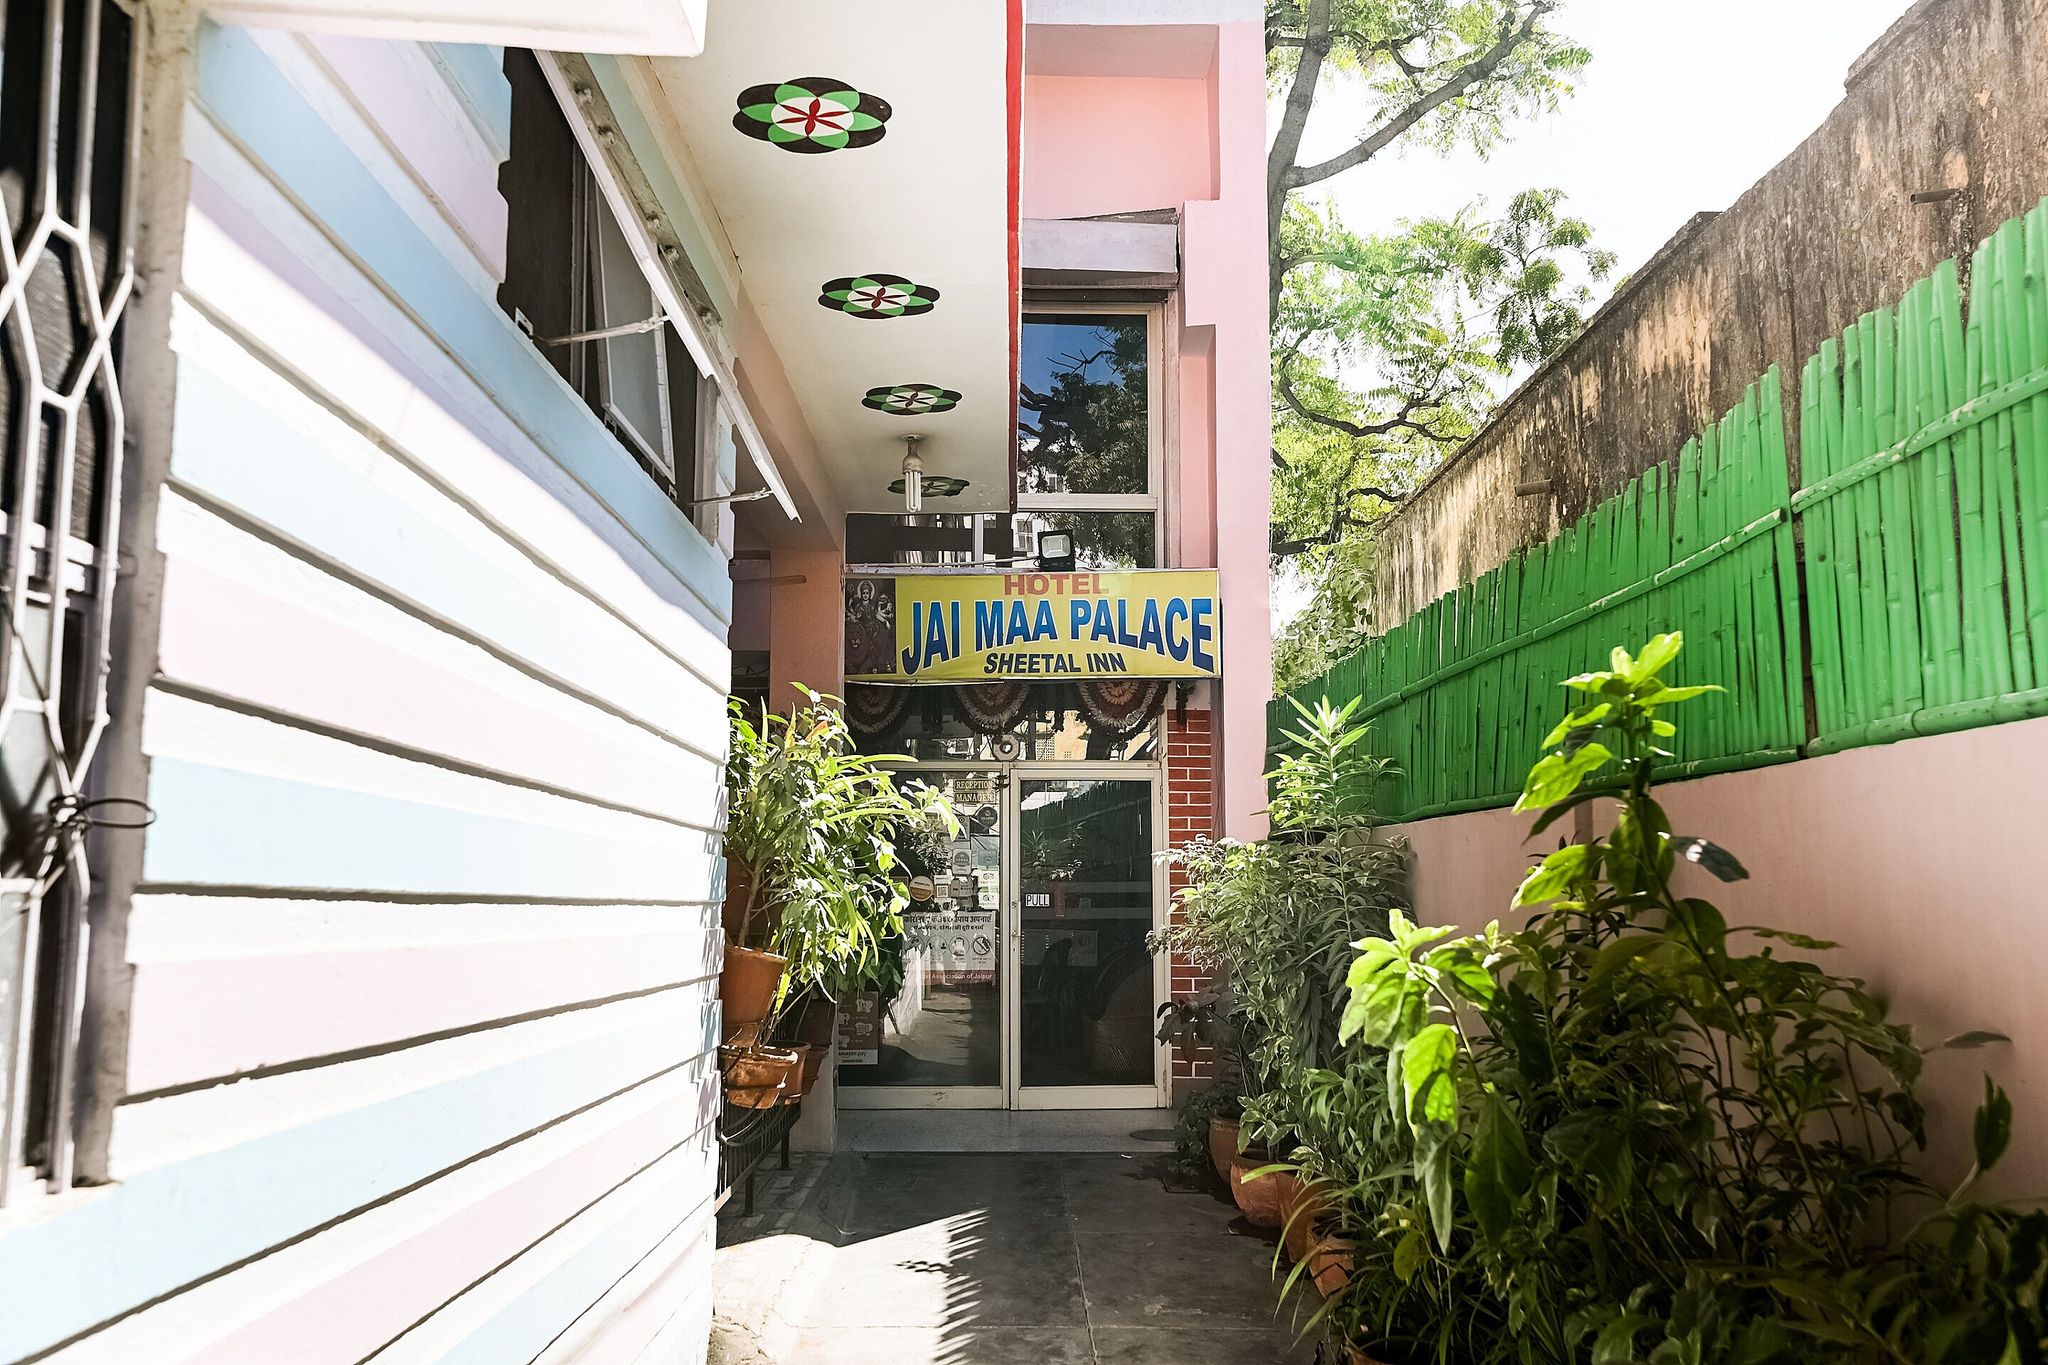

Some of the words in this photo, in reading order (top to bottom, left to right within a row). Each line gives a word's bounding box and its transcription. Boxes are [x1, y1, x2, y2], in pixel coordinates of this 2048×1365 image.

[1004, 573, 1109, 596] HOTEL
[901, 600, 961, 676] JAI
[975, 599, 1057, 652] MAA
[1069, 597, 1216, 674] PALACE
[984, 653, 1082, 674] SHEETAL
[1087, 652, 1127, 673] INN
[956, 780, 993, 791] RECEPTION
[956, 793, 994, 802] MANAGER
[1026, 894, 1049, 906] PULL
